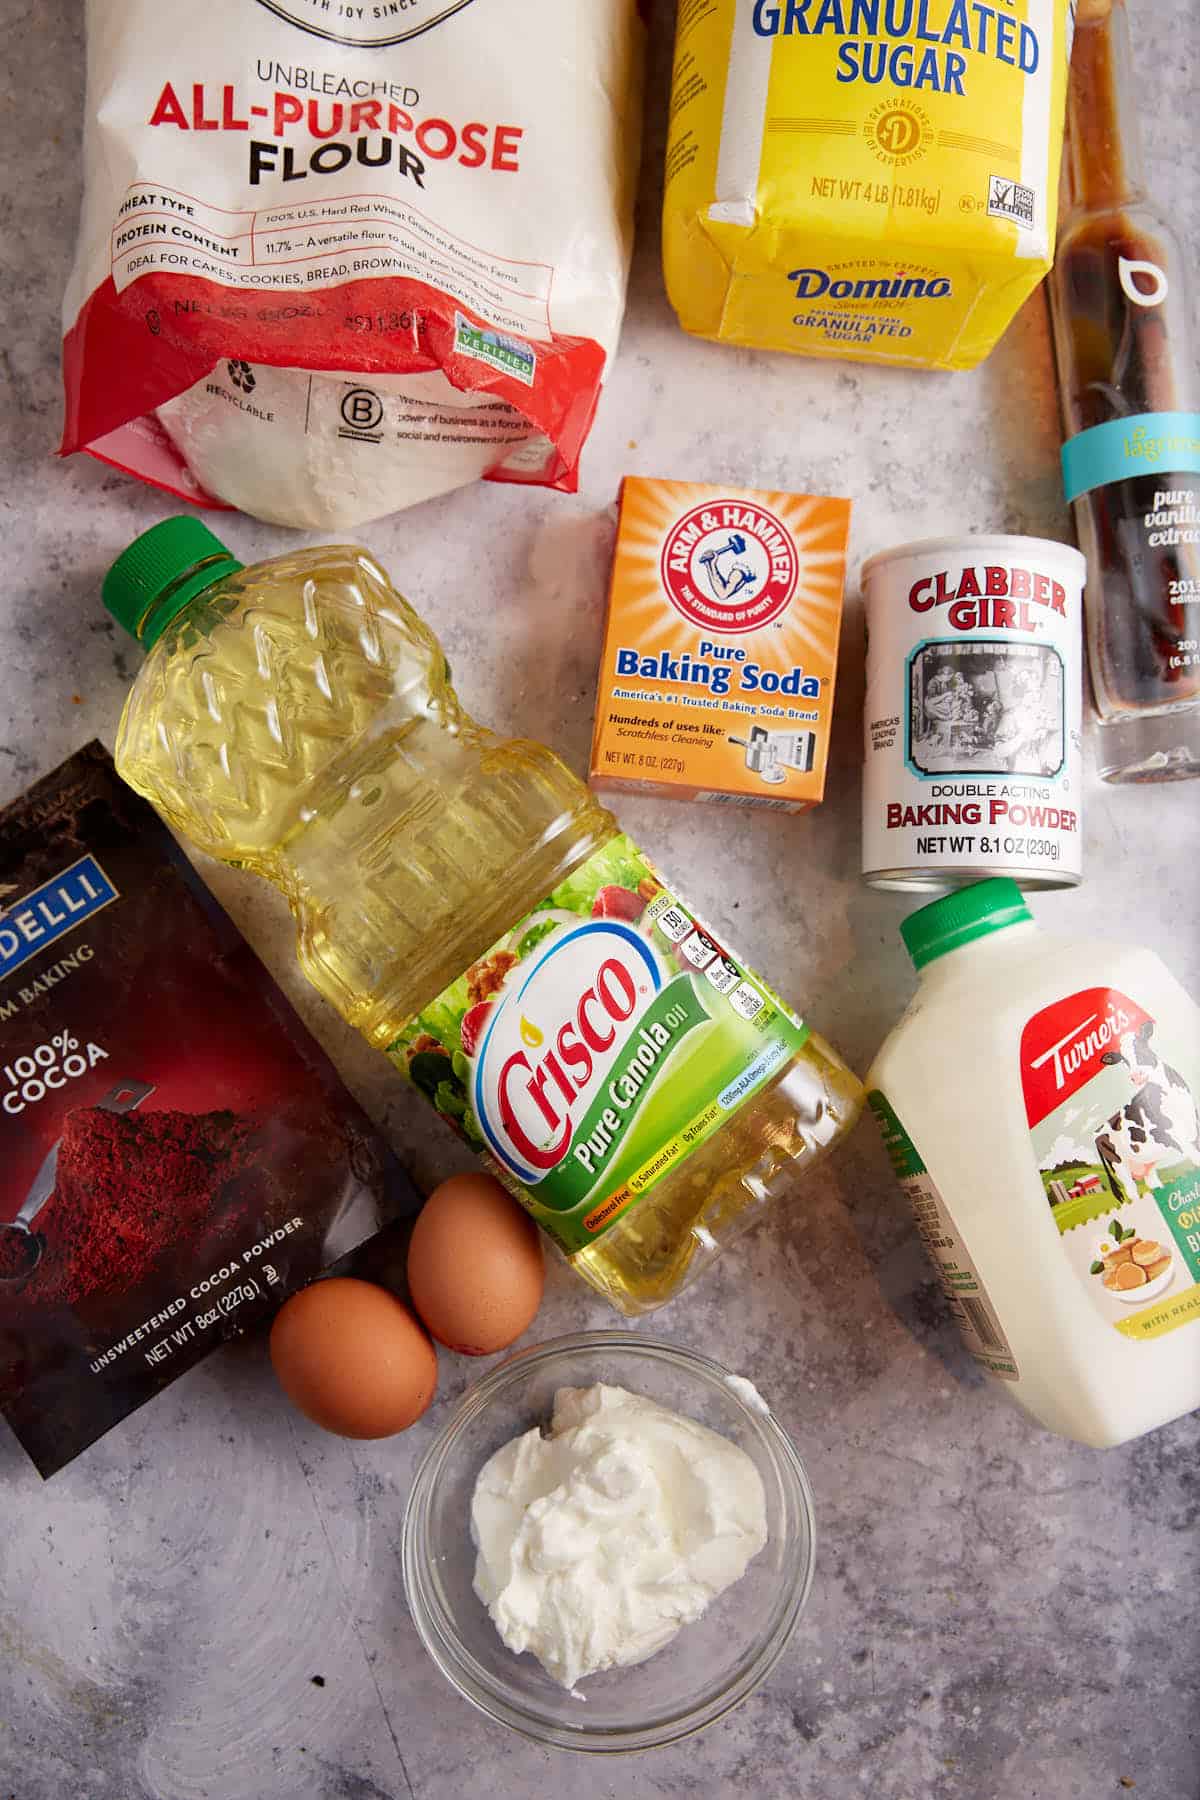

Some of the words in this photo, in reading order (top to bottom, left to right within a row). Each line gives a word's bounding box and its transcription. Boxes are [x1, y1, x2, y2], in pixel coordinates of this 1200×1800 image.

[339, 5, 363, 18] JOY
[752, 0, 1039, 75] GRANULATED
[256, 59, 419, 107] UNBLEACHED
[837, 41, 966, 96] SUGAR
[149, 81, 523, 173] ALL-PURPOSE
[249, 136, 426, 189] FLOUR
[160, 197, 194, 216] TYPE
[811, 177, 836, 197] NET
[839, 179, 862, 200] WT
[864, 183, 871, 200] 4
[875, 183, 889, 203] LB
[891, 185, 941, 215] (1.81kg)
[266, 212, 295, 223] 100%
[298, 210, 318, 220] U.S.
[322, 206, 347, 216] Hard
[350, 205, 370, 214] Red
[374, 204, 406, 220] Wheat
[116, 224, 167, 248] PROTEIN
[171, 227, 239, 257] CONTENT
[266, 240, 292, 254] 11.7%
[307, 237, 316, 248] A
[318, 231, 359, 247] versatile
[361, 230, 385, 241] flour
[388, 233, 398, 242] to
[127, 254, 157, 273] IDEAL
[160, 254, 188, 265] FOR
[192, 259, 237, 282] CAKES,
[240, 274, 304, 285] COOKIES,
[307, 264, 350, 282] BREAD,
[787, 267, 951, 298] Domino
[793, 313, 912, 337] GRANULATED
[824, 330, 873, 343] SUGAR
[463, 332, 530, 374] VERIFIED
[206, 383, 275, 422] RECYCLABLE
[397, 430, 422, 440] social
[423, 431, 441, 441] and
[398, 413, 426, 423] power
[427, 414, 439, 424] of
[440, 415, 478, 427] business
[479, 420, 490, 428] as
[498, 418, 521, 430] force
[1153, 490, 1194, 512] pure
[669, 522, 702, 574] ARM
[701, 512, 721, 531] &
[722, 507, 791, 585] HAMMER
[909, 566, 1067, 618] CLABBER
[948, 598, 1036, 632] GIRL
[700, 642, 745, 661] Pure
[1177, 641, 1197, 651] 200
[617, 650, 731, 693] Baking
[742, 666, 819, 697] Soda
[613, 689, 662, 702] America's
[666, 695, 678, 704] #1
[682, 697, 719, 710] Trusted
[722, 701, 756, 715] Baking
[760, 706, 785, 717] Soda
[788, 709, 818, 721] Brand
[609, 713, 659, 728] Hundreds
[662, 719, 674, 730] of
[677, 722, 700, 733] uses
[702, 724, 726, 737] like:
[616, 727, 670, 743] Scratchless
[672, 734, 714, 749] Cleaning
[605, 751, 621, 763] NET
[637, 754, 644, 765] 8
[646, 756, 659, 768] OZ.
[660, 757, 686, 773] (227g)
[931, 785, 997, 798] DOUBLE
[1000, 786, 1050, 800] ACTING
[887, 803, 981, 829] BAKING
[989, 800, 1077, 832] POWDER
[917, 837, 947, 854] NET
[949, 837, 975, 854] WT
[980, 837, 1000, 854] 8.1
[1003, 837, 1025, 854] OZ
[1026, 840, 1060, 861] (230g)
[662, 909, 683, 930] 130
[18, 944, 95, 1004] BAKING
[4, 1029, 79, 1086] 100%
[1031, 1003, 1129, 1089] Turner's
[3, 1042, 109, 1114] COCOA
[574, 1109, 621, 1174] Pure
[608, 1021, 671, 1111] Canola
[666, 1002, 690, 1029] Oil
[637, 1152, 670, 1184] Saturated
[584, 1198, 619, 1231] Cholesterol
[613, 1188, 631, 1206] Free
[90, 1298, 187, 1374] UNSWEETENED
[190, 1261, 240, 1299] COCOA
[242, 1217, 305, 1263] POWDER
[144, 1338, 175, 1366] NET
[171, 1321, 196, 1346] WT
[195, 1308, 220, 1330] 8oz
[216, 1278, 260, 1316] (227g)
[1142, 1310, 1169, 1331] WITH
